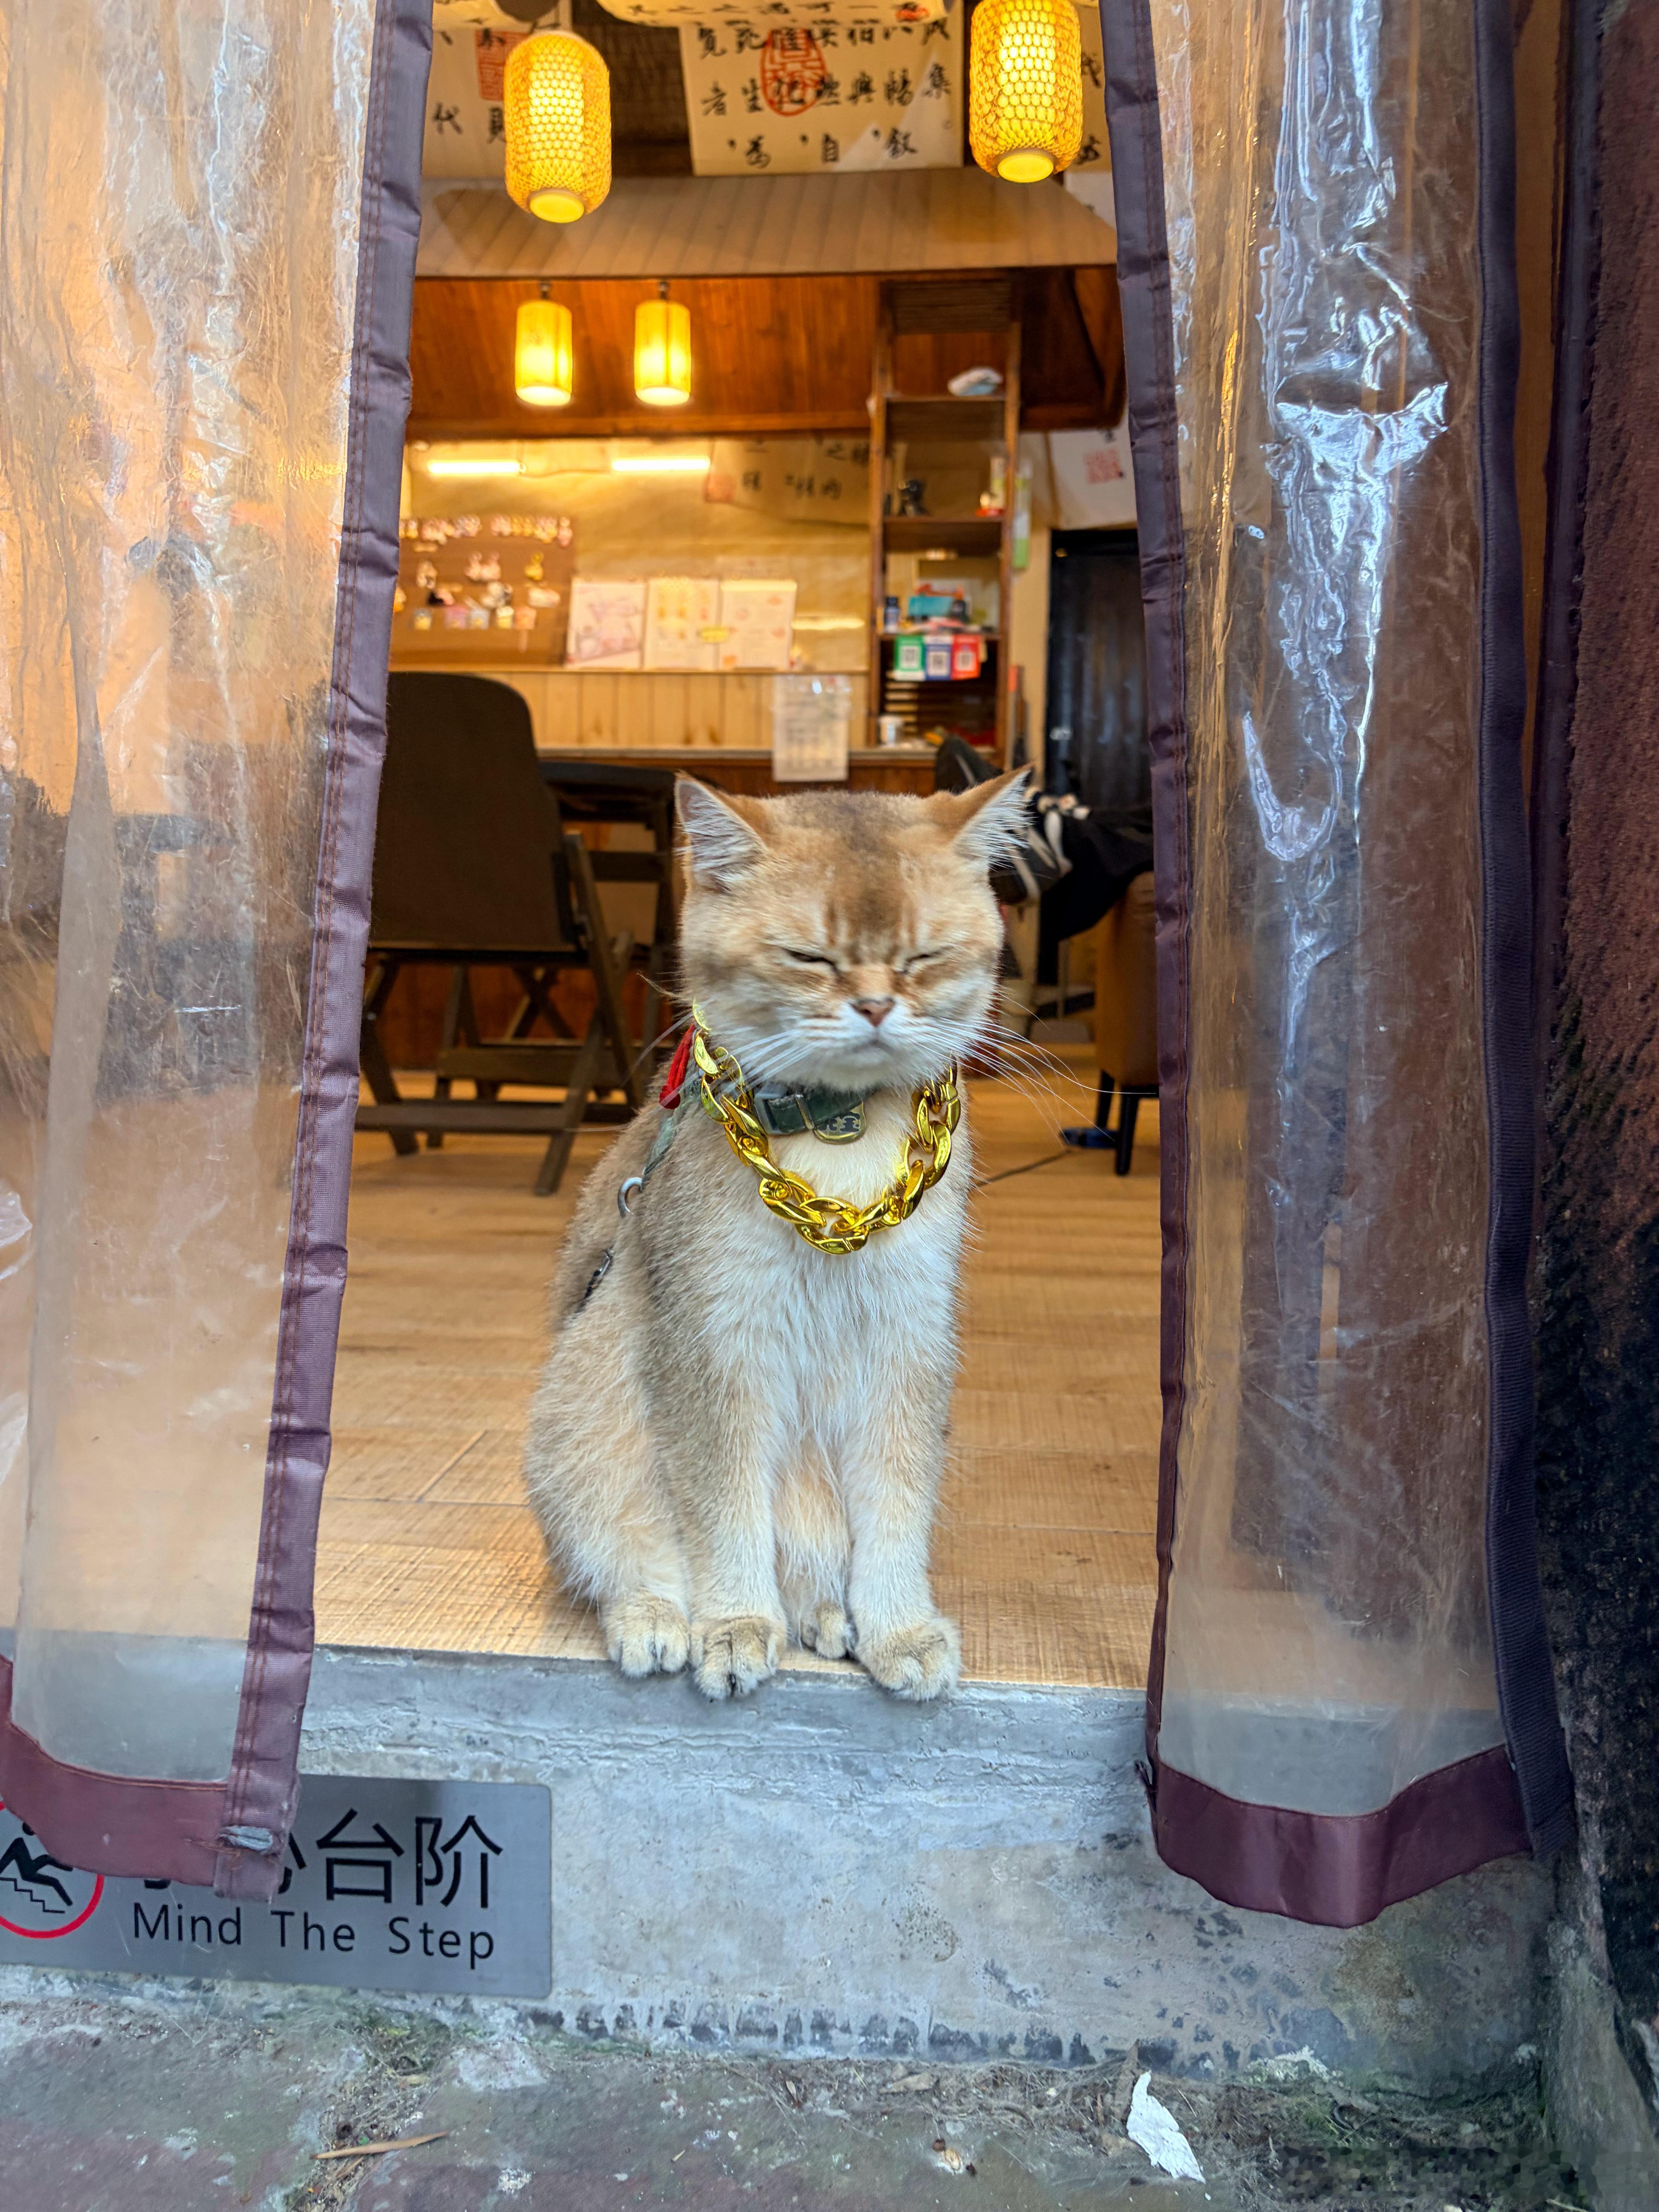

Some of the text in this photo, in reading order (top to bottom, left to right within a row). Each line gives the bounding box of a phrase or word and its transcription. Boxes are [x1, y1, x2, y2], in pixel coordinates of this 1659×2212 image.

[134, 1902, 494, 1970] Mind The Step
